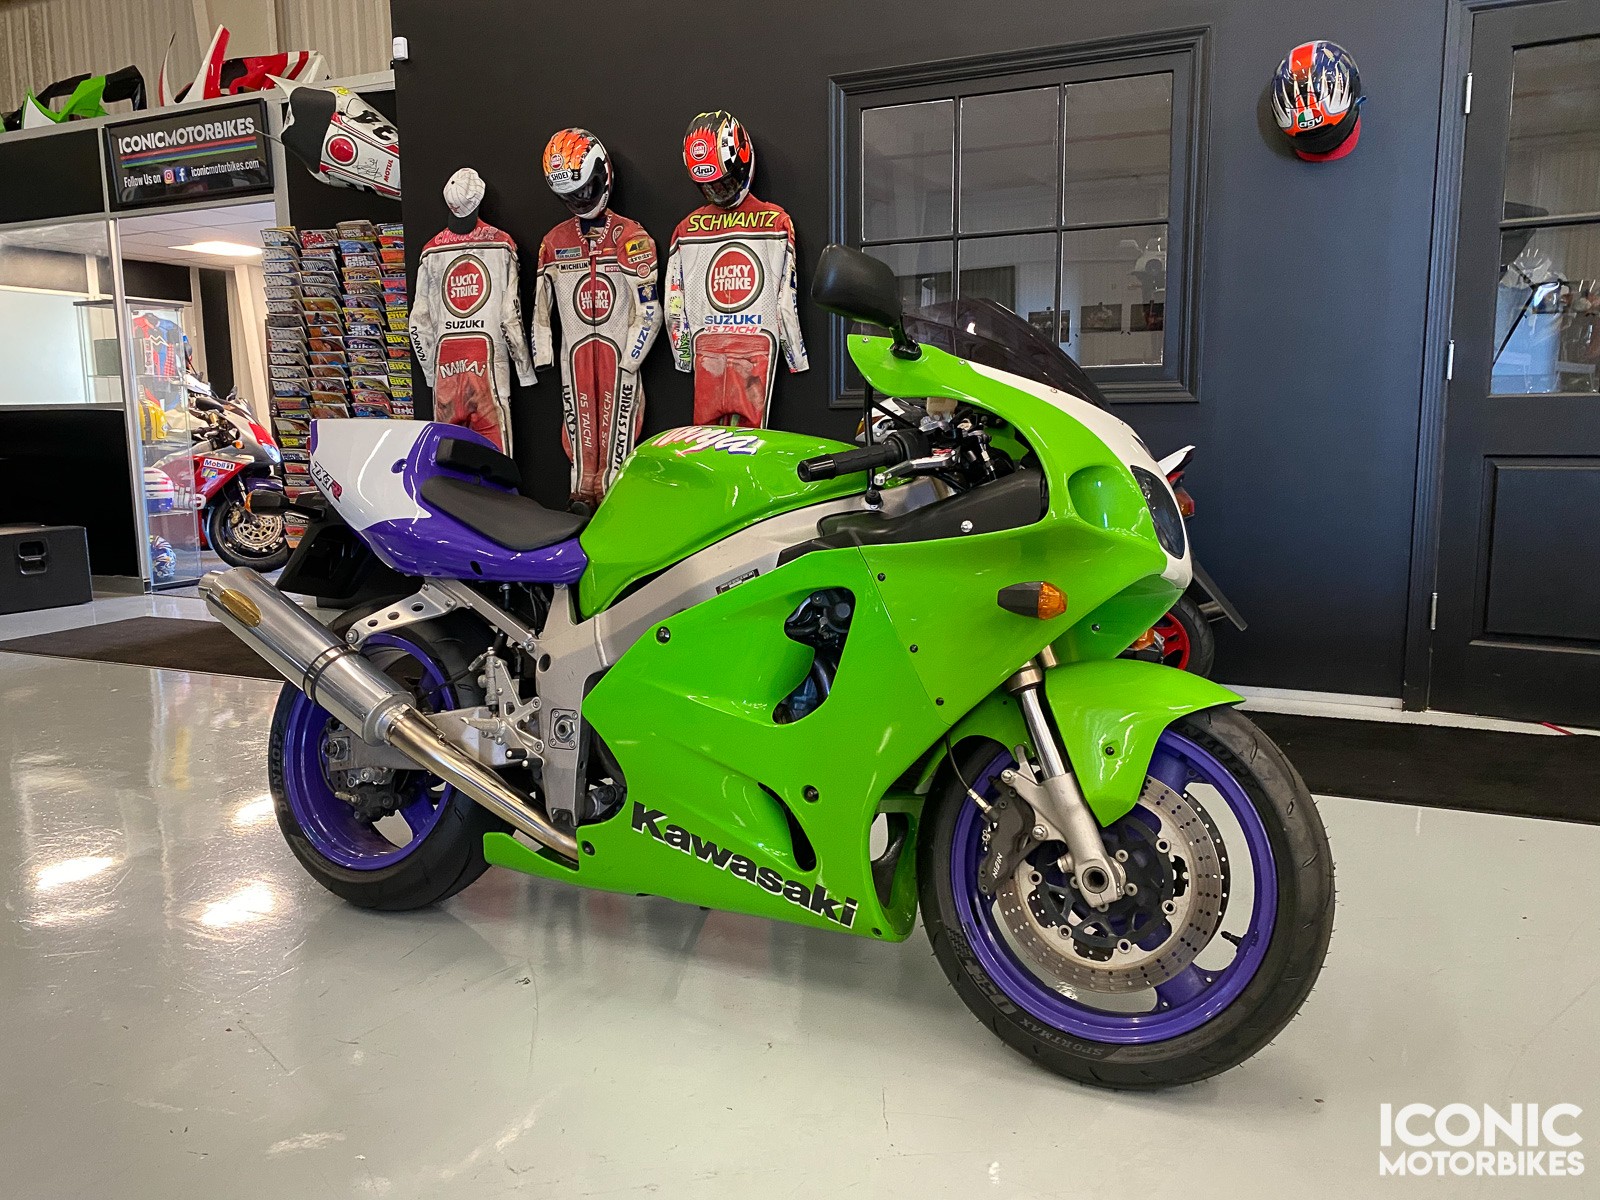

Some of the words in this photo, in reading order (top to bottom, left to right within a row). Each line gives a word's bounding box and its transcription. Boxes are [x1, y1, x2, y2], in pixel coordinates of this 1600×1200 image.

[1299, 116, 1324, 128] agv
[118, 117, 256, 154] ICONICMOTORBIKES
[124, 174, 143, 188] Follow
[144, 173, 153, 184] Us
[153, 174, 162, 184] on
[190, 160, 260, 177] iconicmotorbikes.com
[384, 160, 394, 182] MOTUL
[551, 171, 569, 180] SHOEI
[693, 166, 714, 175] Arai
[687, 210, 780, 232] SCHWANTZ
[597, 214, 613, 244] SUZUKI
[560, 262, 588, 271] MICHELIN
[714, 264, 751, 279] LUCKY
[450, 273, 480, 287] LUCKY
[713, 278, 752, 292] STRIKE
[450, 285, 479, 299] STRIKE
[445, 319, 485, 330] SUZUKI
[704, 314, 762, 325] SUZUKI
[721, 325, 758, 334] TAICHI
[580, 392, 589, 408] RS
[618, 383, 634, 429] STRIKE
[602, 390, 613, 427] TAICHI
[581, 411, 593, 448] TAICHI
[613, 428, 627, 471] LUCKY
[204, 459, 226, 469] Mobil
[631, 800, 859, 929] Kawasaki
[1019, 1016, 1104, 1056] SPORTMAX
